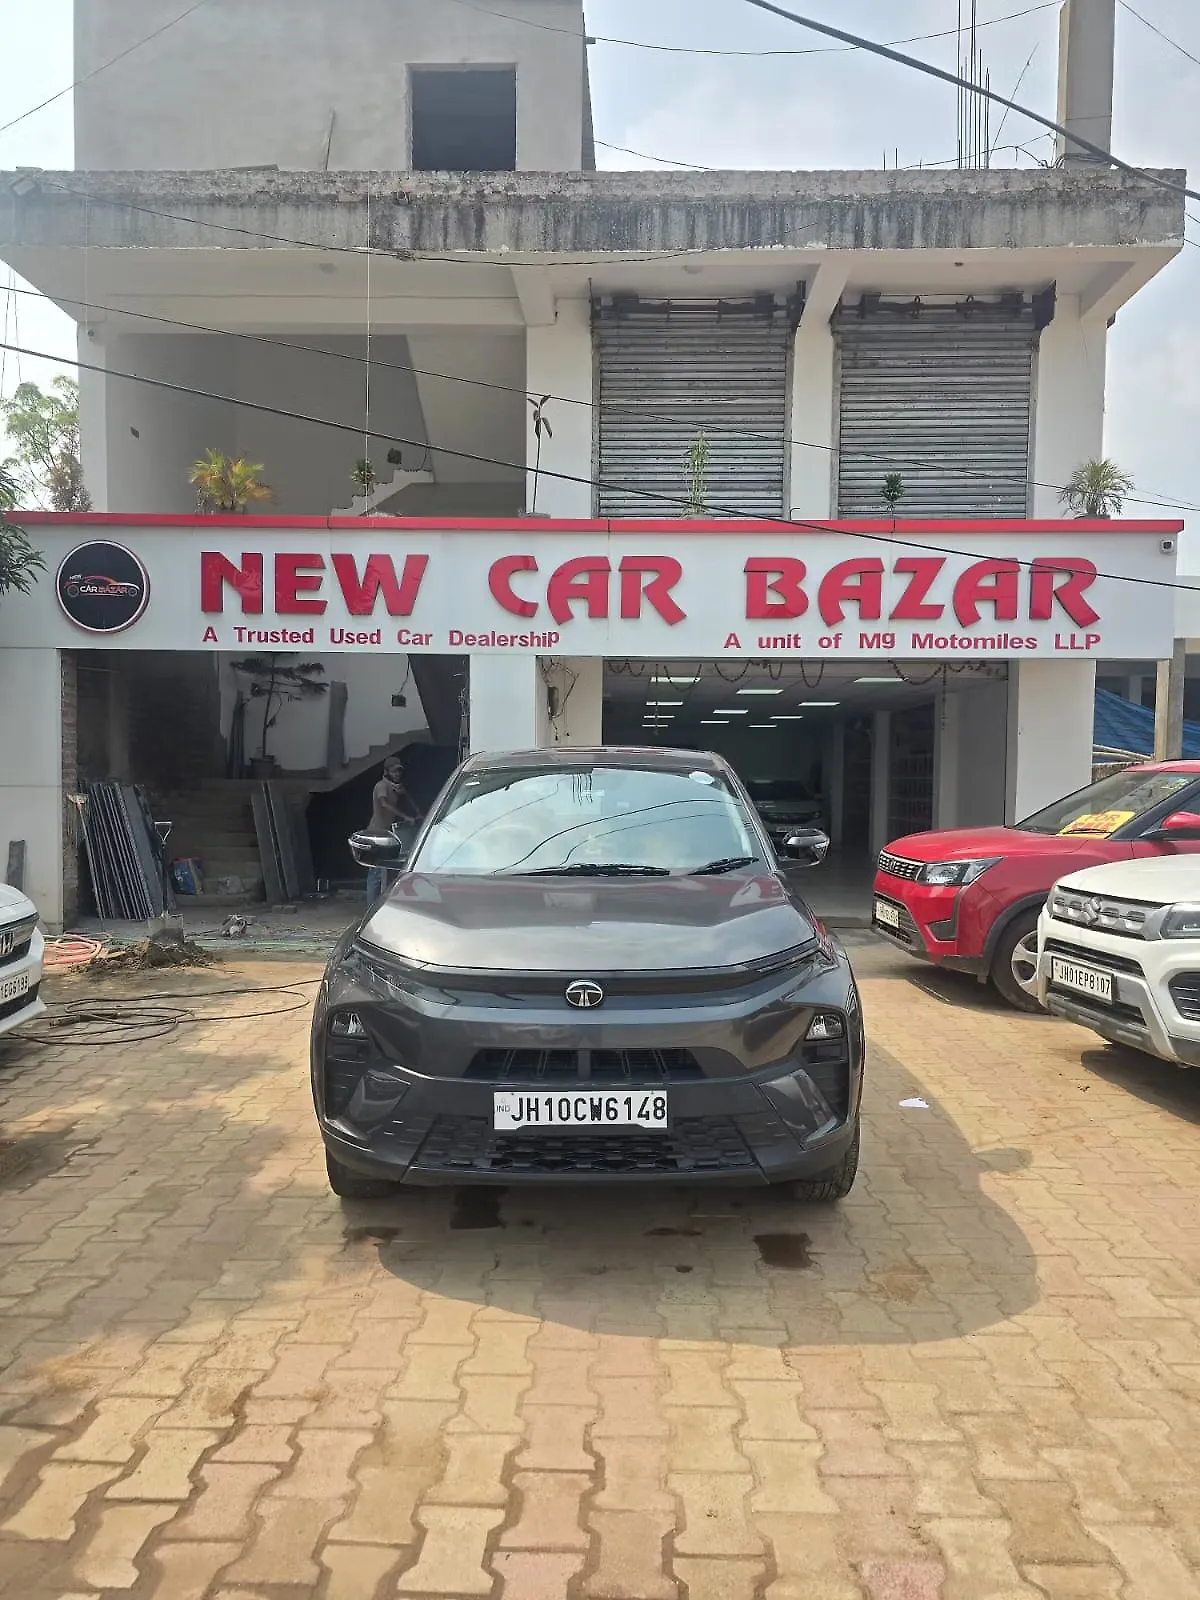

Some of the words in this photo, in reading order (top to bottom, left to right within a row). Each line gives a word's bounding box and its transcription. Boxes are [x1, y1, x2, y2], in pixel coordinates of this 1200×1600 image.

[200, 551, 430, 616] NEW
[487, 555, 688, 626] CAR
[743, 556, 1101, 628] BAZAR
[202, 627, 218, 643] A
[234, 626, 315, 645] Trusted
[329, 628, 381, 646] Used
[397, 630, 433, 647] Car
[448, 629, 560, 648] Dealership
[723, 633, 742, 650] A
[757, 633, 801, 650] unit
[817, 632, 842, 650] of
[911, 632, 1038, 651] Motomiles
[1054, 634, 1102, 651] LLP
[1059, 964, 1110, 994] JH01EP8107
[496, 1104, 511, 1113] IND
[511, 1096, 666, 1122] JH10CW6148
